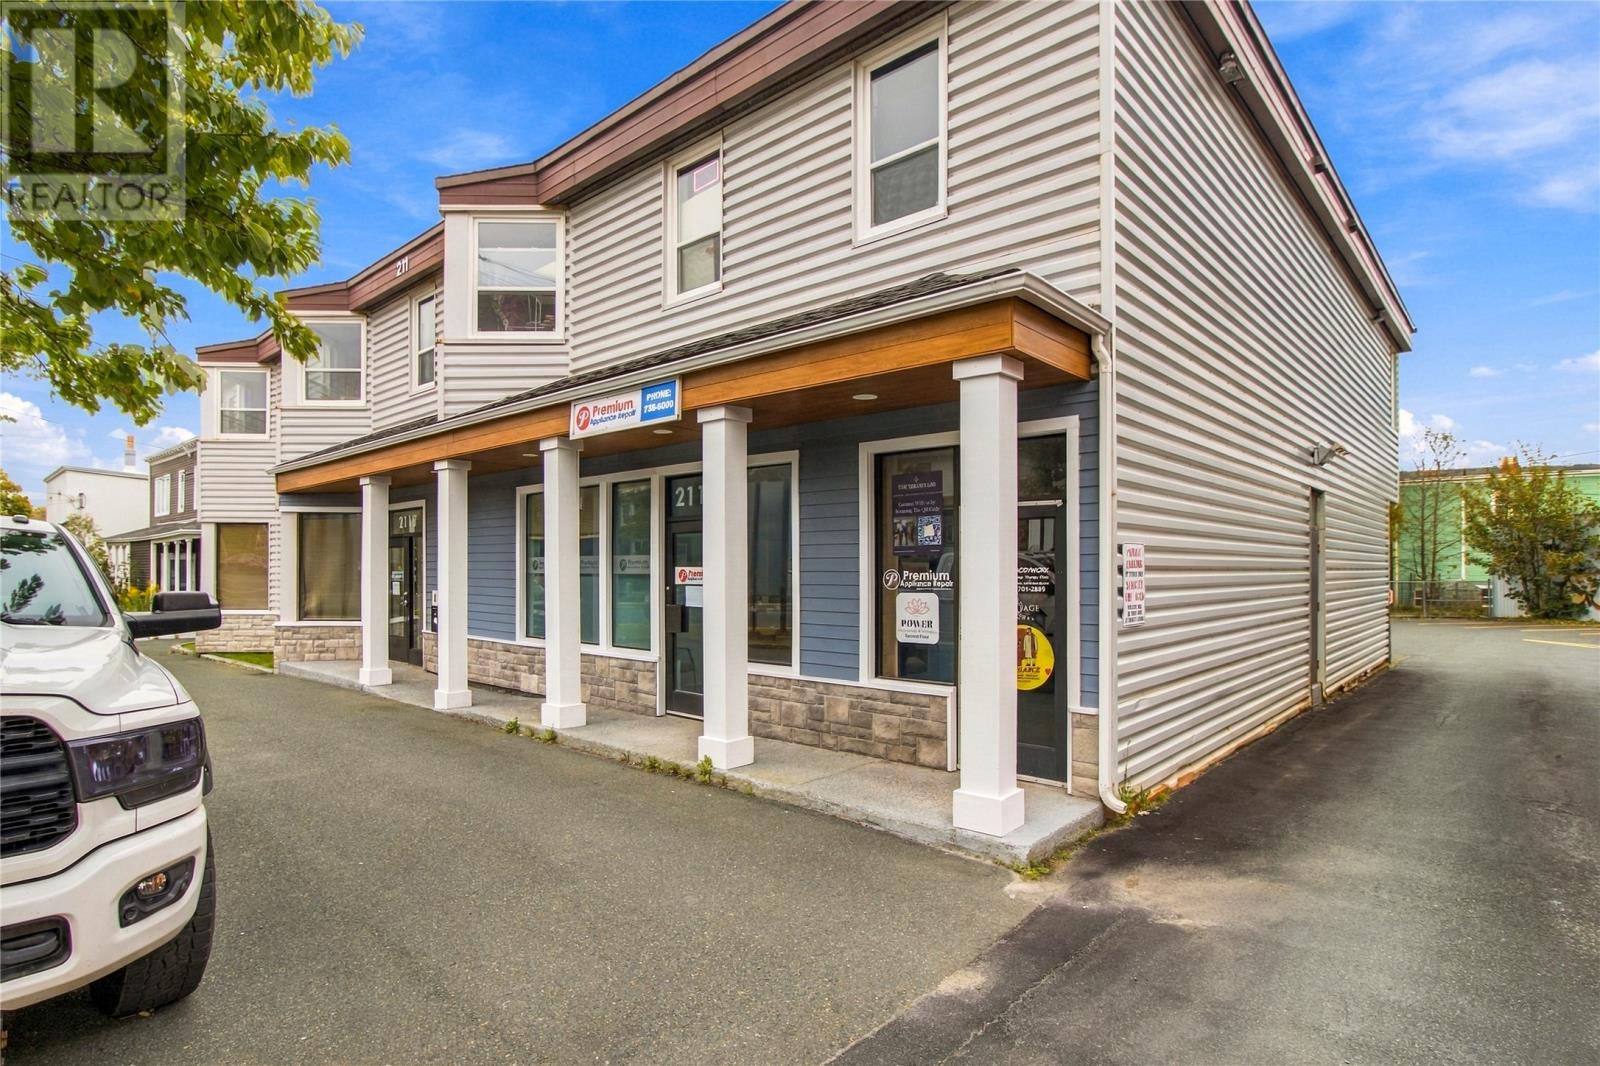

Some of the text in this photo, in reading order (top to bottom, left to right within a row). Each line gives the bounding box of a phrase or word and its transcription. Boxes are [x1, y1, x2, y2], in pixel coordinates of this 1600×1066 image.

[396, 256, 409, 277] 211
[592, 399, 634, 417] Premium
[590, 409, 637, 427] Appliance Repair
[903, 570, 950, 581] Premium
[900, 580, 954, 588] Appliance Repair
[901, 619, 933, 628] POWER
